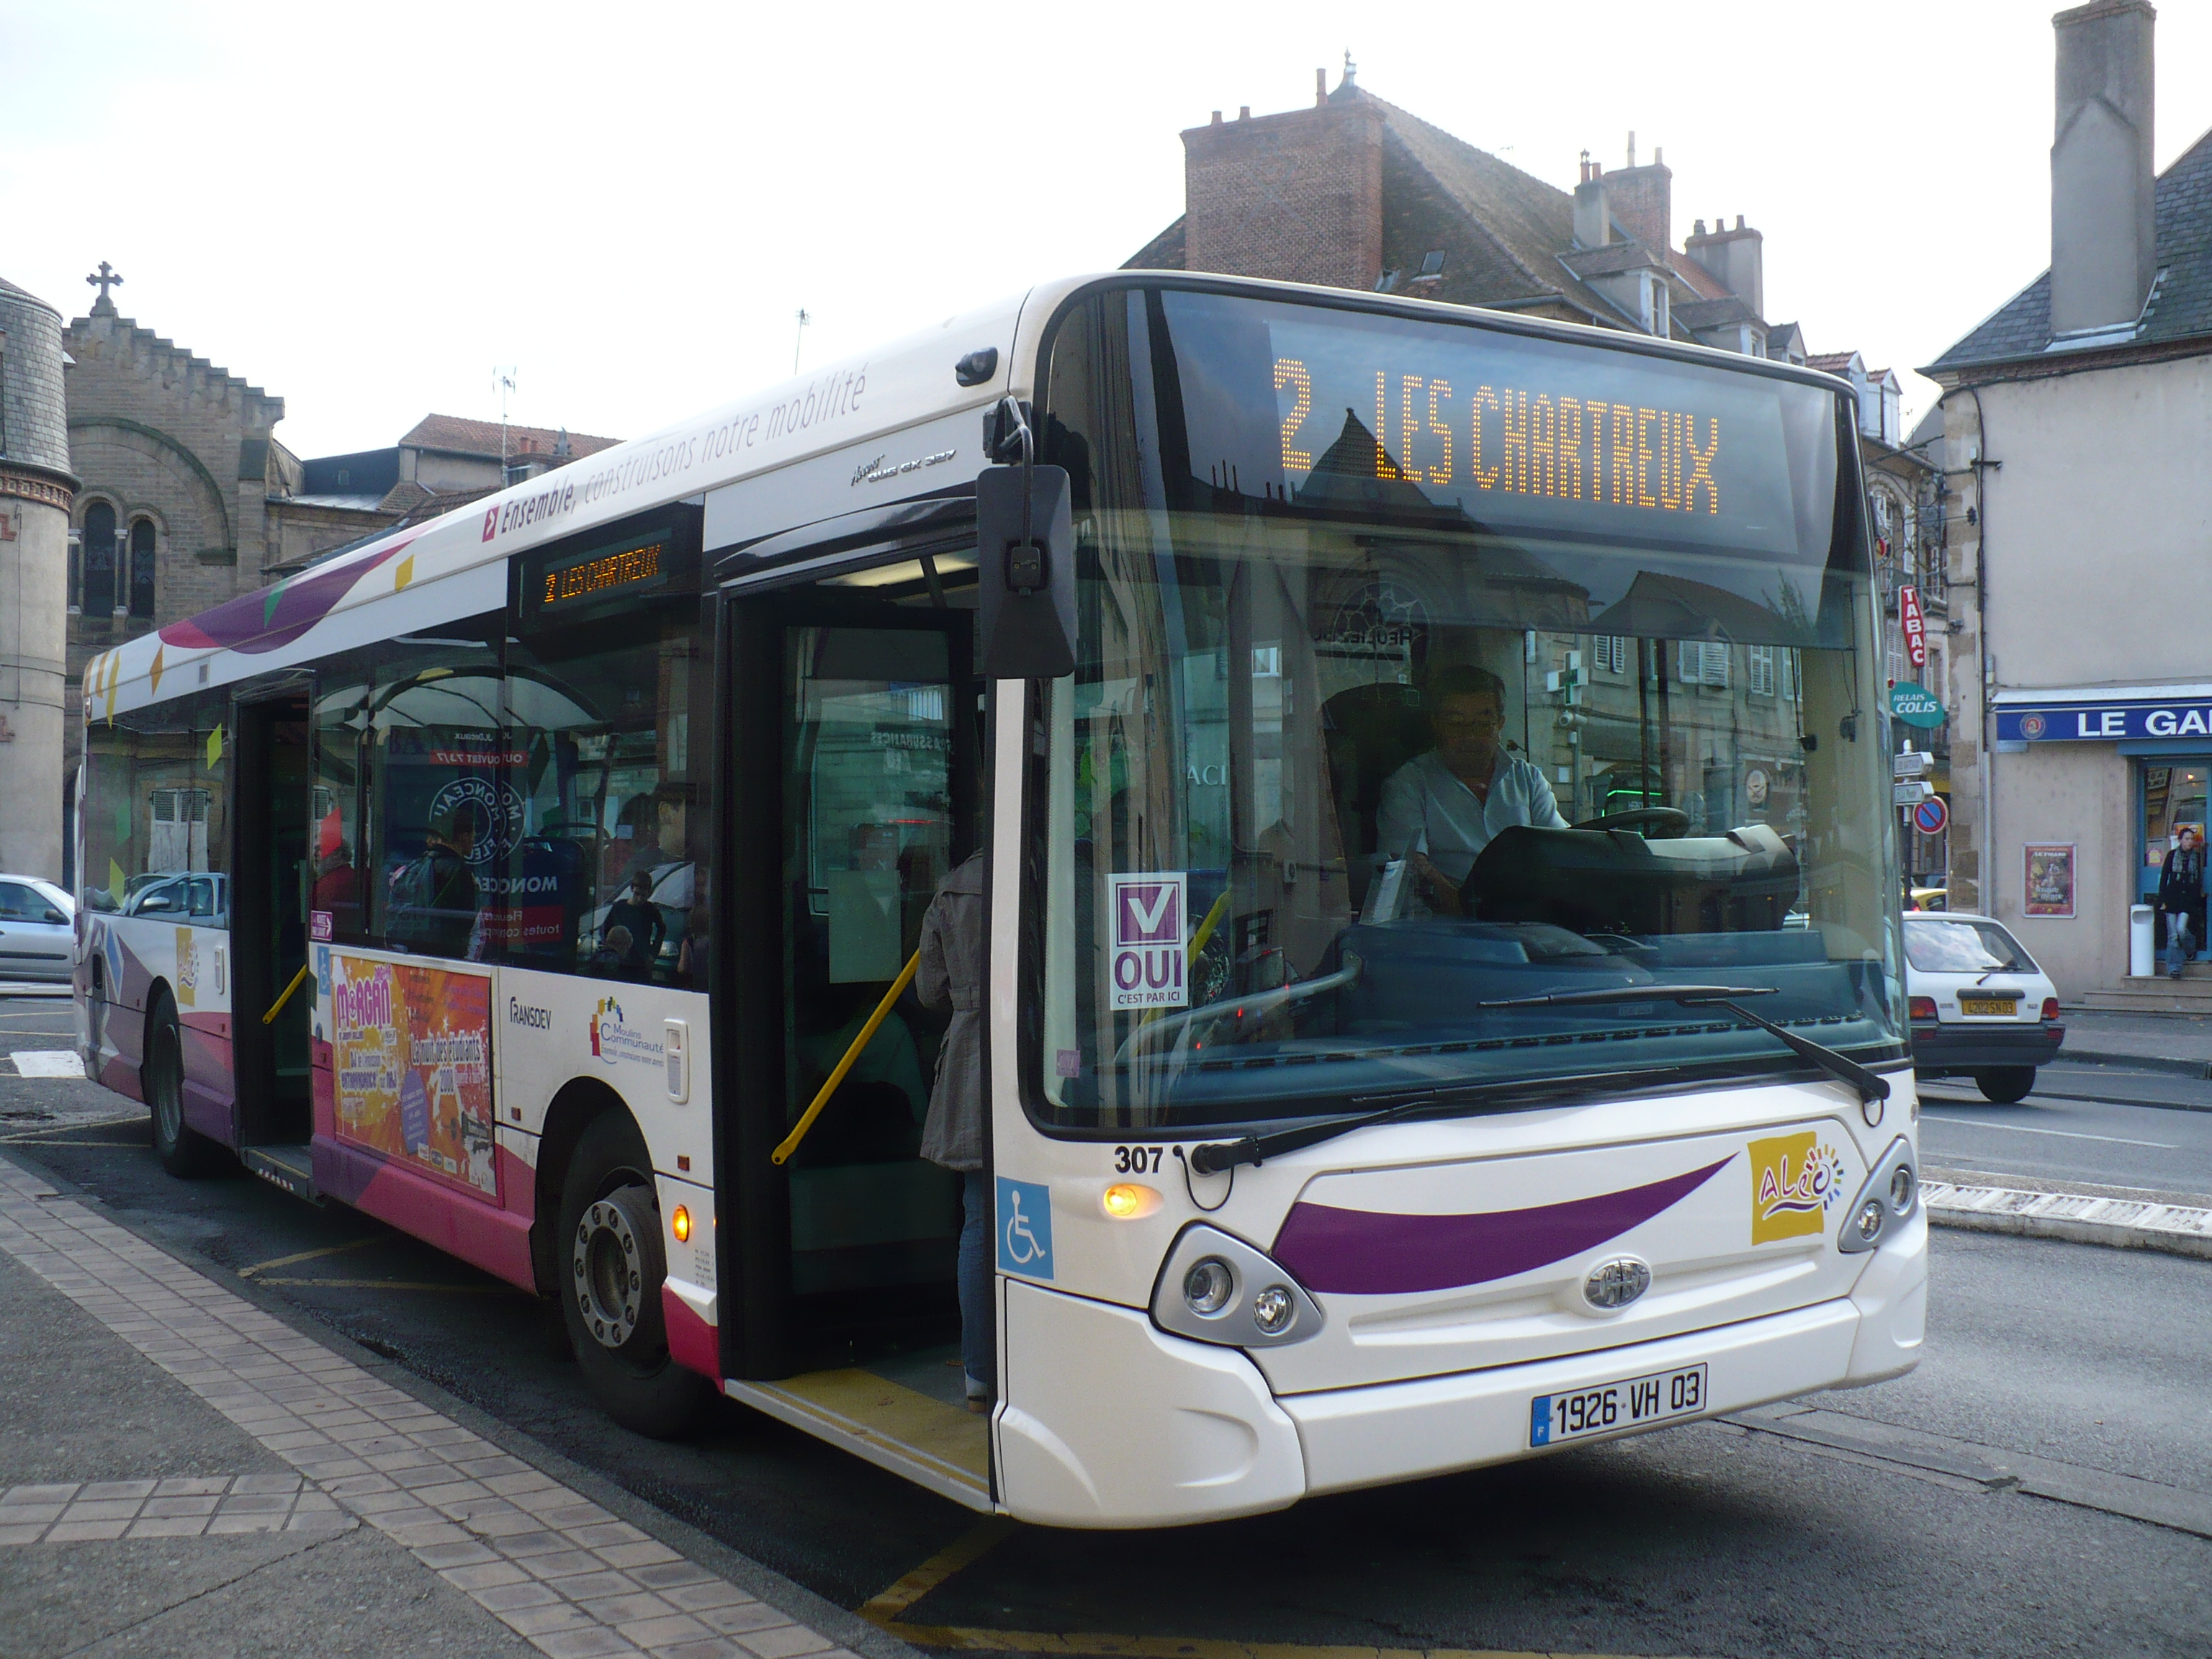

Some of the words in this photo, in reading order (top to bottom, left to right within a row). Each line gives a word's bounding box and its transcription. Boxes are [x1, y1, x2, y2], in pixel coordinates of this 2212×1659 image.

[500, 475, 576, 534] Ensemble,
[585, 437, 696, 504] construisons
[701, 412, 760, 464] notre
[766, 361, 869, 442] mobilité
[1273, 357, 1311, 470] 2
[1375, 370, 1453, 485] LES
[1472, 384, 1719, 515] CHARTREUX
[544, 573, 557, 604] 2
[1903, 588, 1925, 664] TABAC
[1893, 693, 1925, 702] RELAIS
[1895, 701, 1937, 714] COLIS
[2077, 711, 2126, 737] LE
[2144, 709, 2212, 737] GA
[1113, 950, 1182, 991] OUI
[1117, 991, 1145, 1004] C'EST
[1146, 991, 1166, 1004] PAR
[1167, 989, 1180, 1002] ICI
[509, 996, 552, 1030] TRANSDEV
[601, 1022, 664, 1054] Communauté
[613, 1023, 642, 1040] Moulins
[1113, 1146, 1164, 1174] 307
[1555, 1389, 1617, 1435] 1926
[1629, 1381, 1659, 1419] VH
[1671, 1370, 1701, 1410] 03
[1537, 1426, 1546, 1437] F
